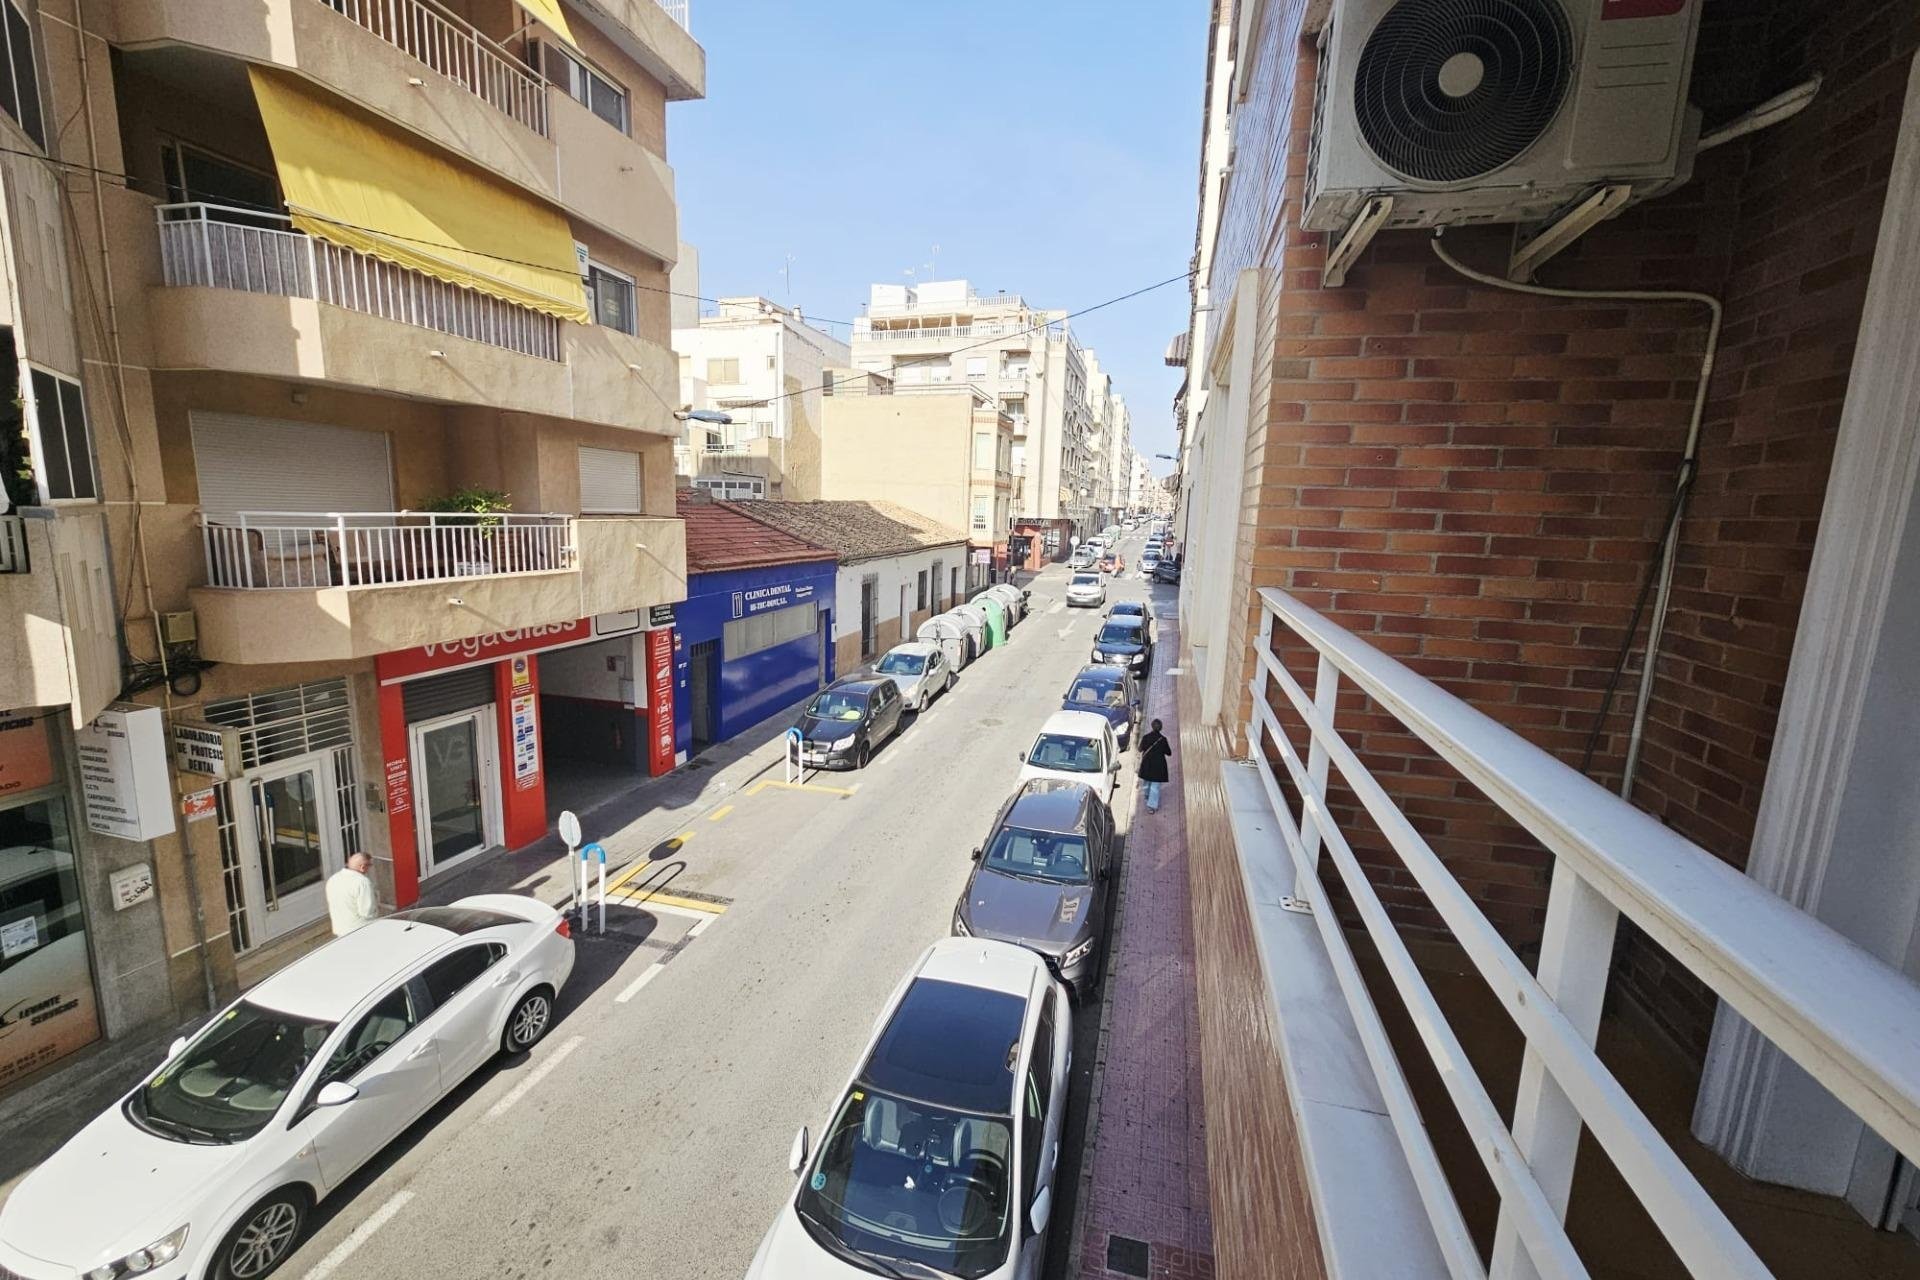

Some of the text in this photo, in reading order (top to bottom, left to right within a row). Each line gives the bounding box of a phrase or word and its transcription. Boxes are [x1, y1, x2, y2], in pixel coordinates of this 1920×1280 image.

[771, 584, 792, 596] DENTAL
[174, 727, 222, 746] LABORATORIO
[177, 742, 223, 760] DE PROTESIS
[188, 758, 215, 774] DENTAL
[19, 994, 61, 1019] LEVANTE
